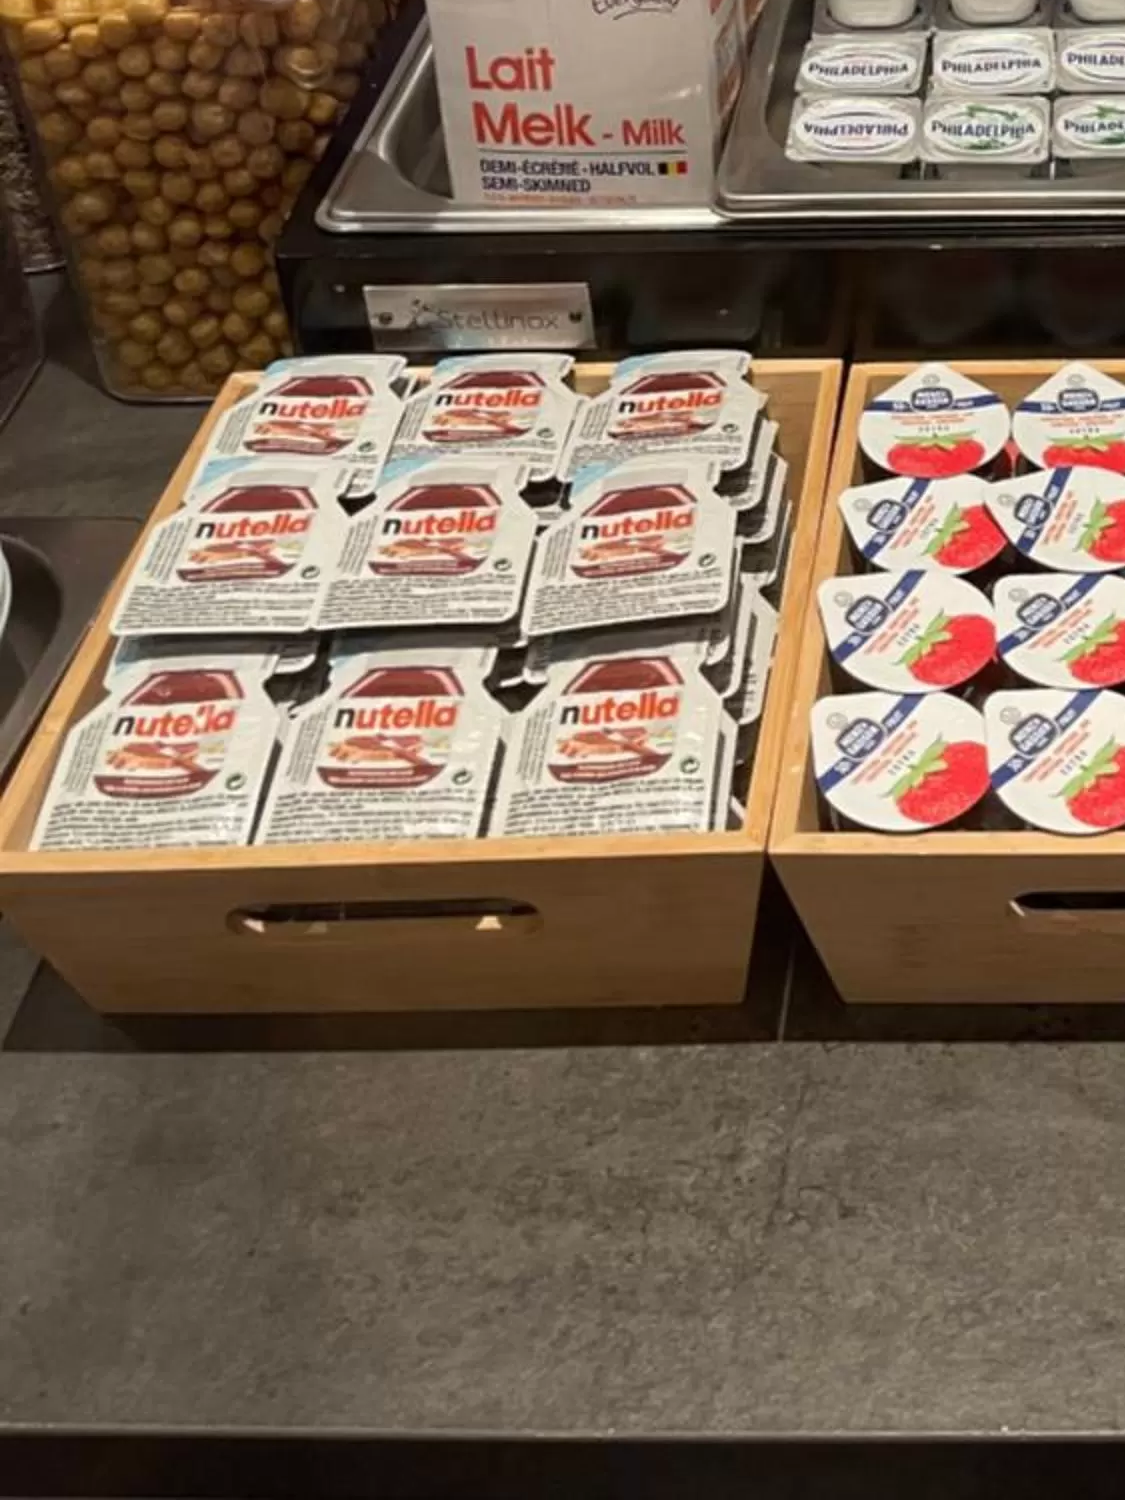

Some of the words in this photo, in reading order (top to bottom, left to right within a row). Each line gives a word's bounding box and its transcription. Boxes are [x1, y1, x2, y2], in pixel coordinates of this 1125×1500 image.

[465, 46, 558, 91] Lait
[808, 62, 909, 77] PHILADELPHIA
[941, 57, 1042, 72] PHILADELPHIA
[472, 101, 596, 148] Melk
[622, 119, 686, 146] Milk
[931, 121, 1036, 138] PHILADELPHIA
[259, 400, 367, 419] nutella
[434, 388, 540, 407] nutella
[618, 389, 724, 414] nutella
[196, 513, 312, 539] nutella
[383, 511, 497, 536] nutella
[581, 510, 695, 540] nutella
[334, 700, 459, 729] nutella
[560, 692, 682, 725] nutella
